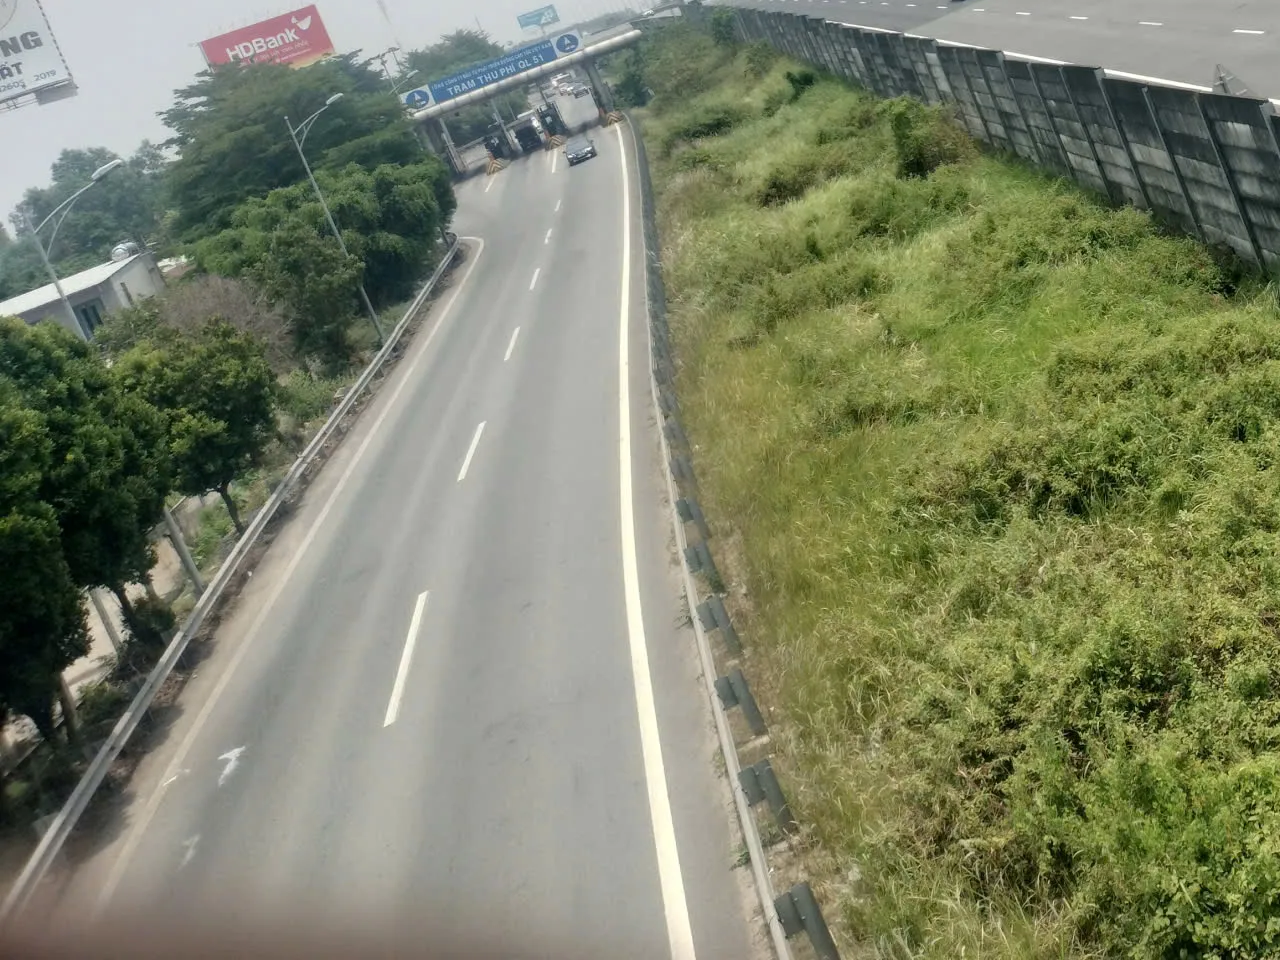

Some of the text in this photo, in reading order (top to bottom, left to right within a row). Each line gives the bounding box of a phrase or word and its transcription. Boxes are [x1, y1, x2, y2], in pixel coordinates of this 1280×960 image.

[225, 28, 300, 62] HDBank
[477, 72, 498, 85] THU
[518, 59, 532, 70] QL
[533, 54, 544, 64] 51
